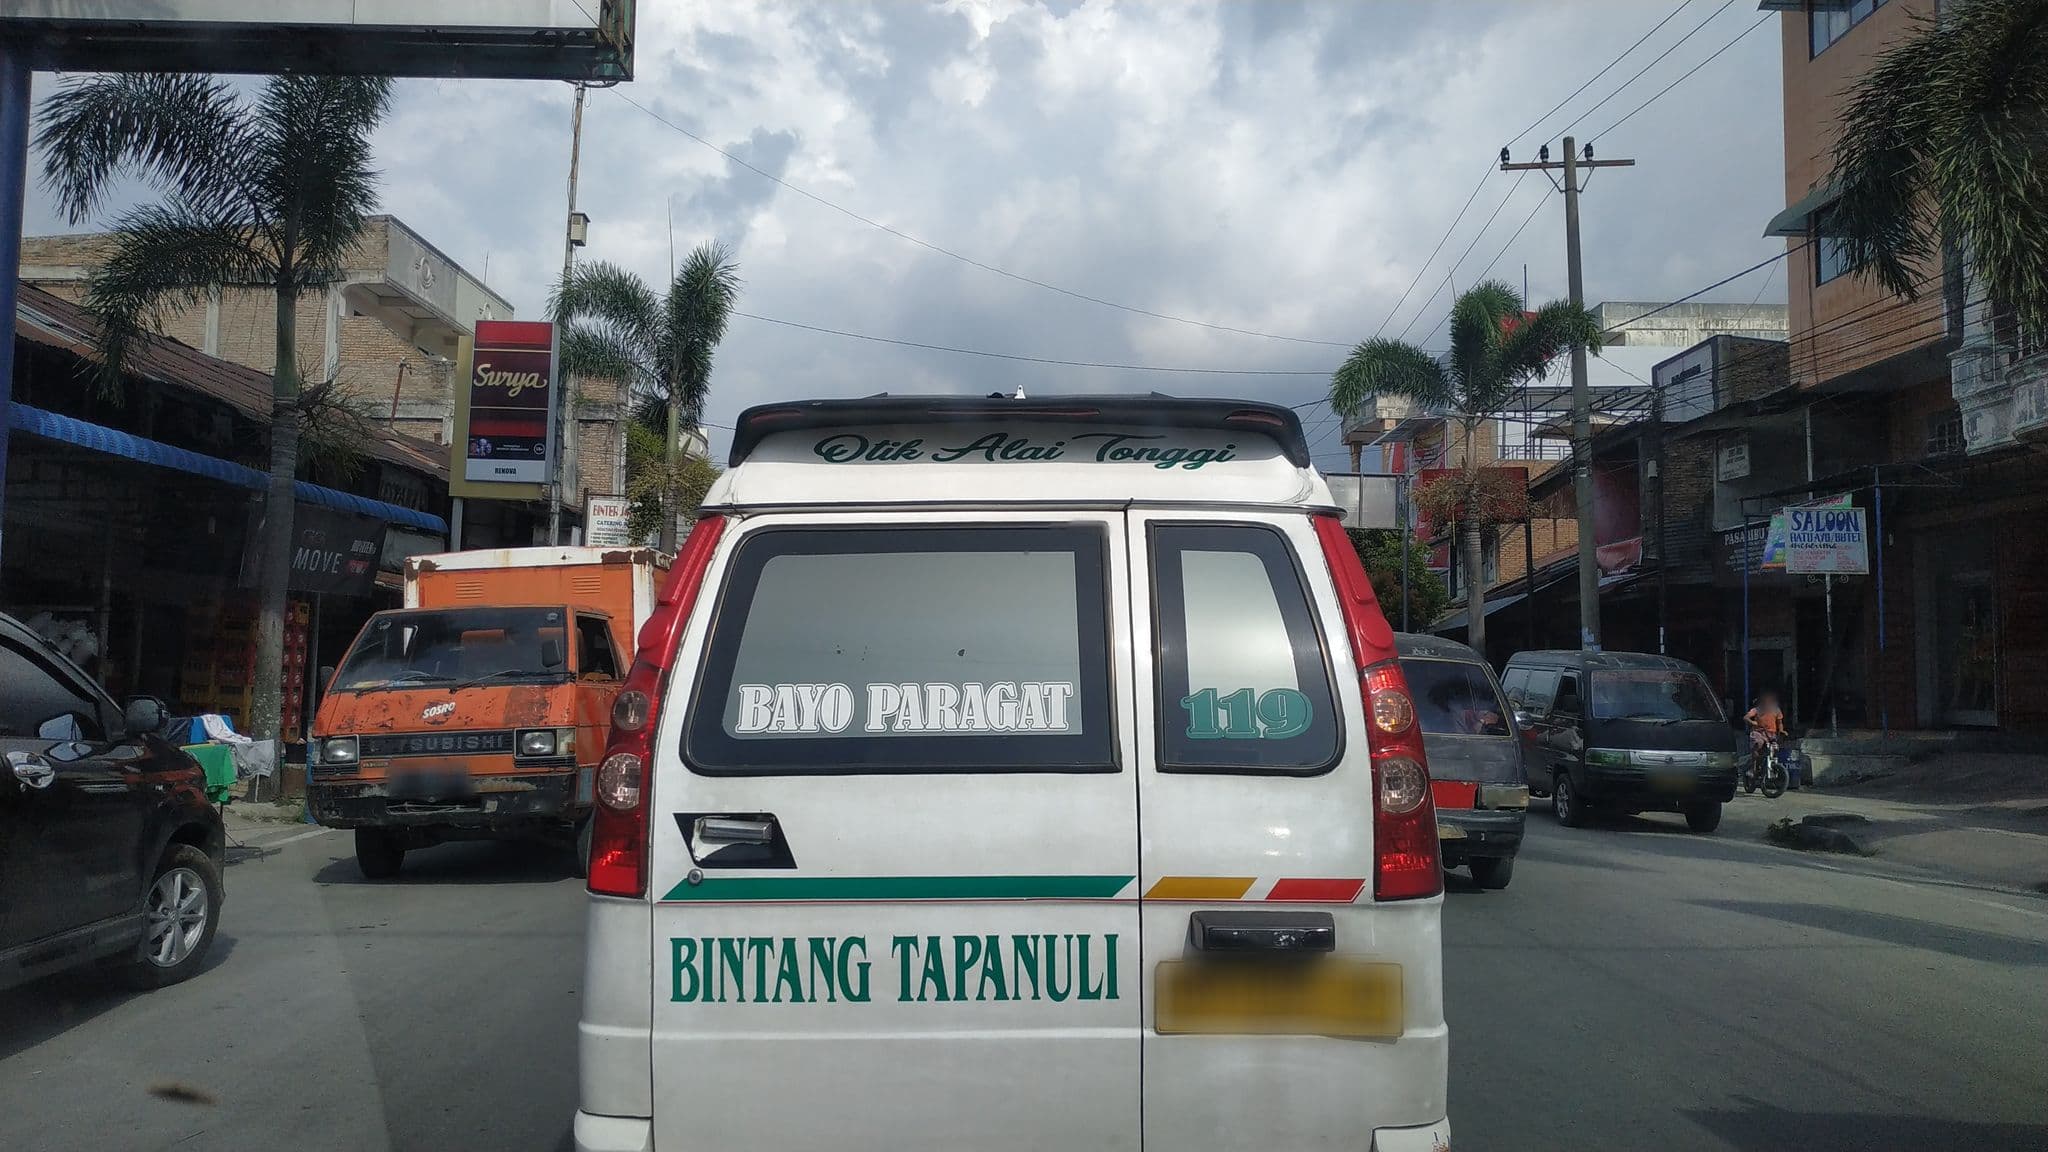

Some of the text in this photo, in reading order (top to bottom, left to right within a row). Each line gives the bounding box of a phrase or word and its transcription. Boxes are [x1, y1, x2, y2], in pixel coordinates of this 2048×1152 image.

[473, 363, 547, 397] Surya
[932, 432, 1066, 462] Alai
[1072, 433, 1236, 470] Tonggi
[1791, 510, 1860, 532] SALOON
[292, 547, 343, 574] MOVE
[422, 702, 456, 719] SOSRO
[735, 682, 1073, 733] BAYO PARAGAT
[1180, 688, 1313, 739] 119
[670, 933, 1120, 1002] BINTANG TAPANULI
